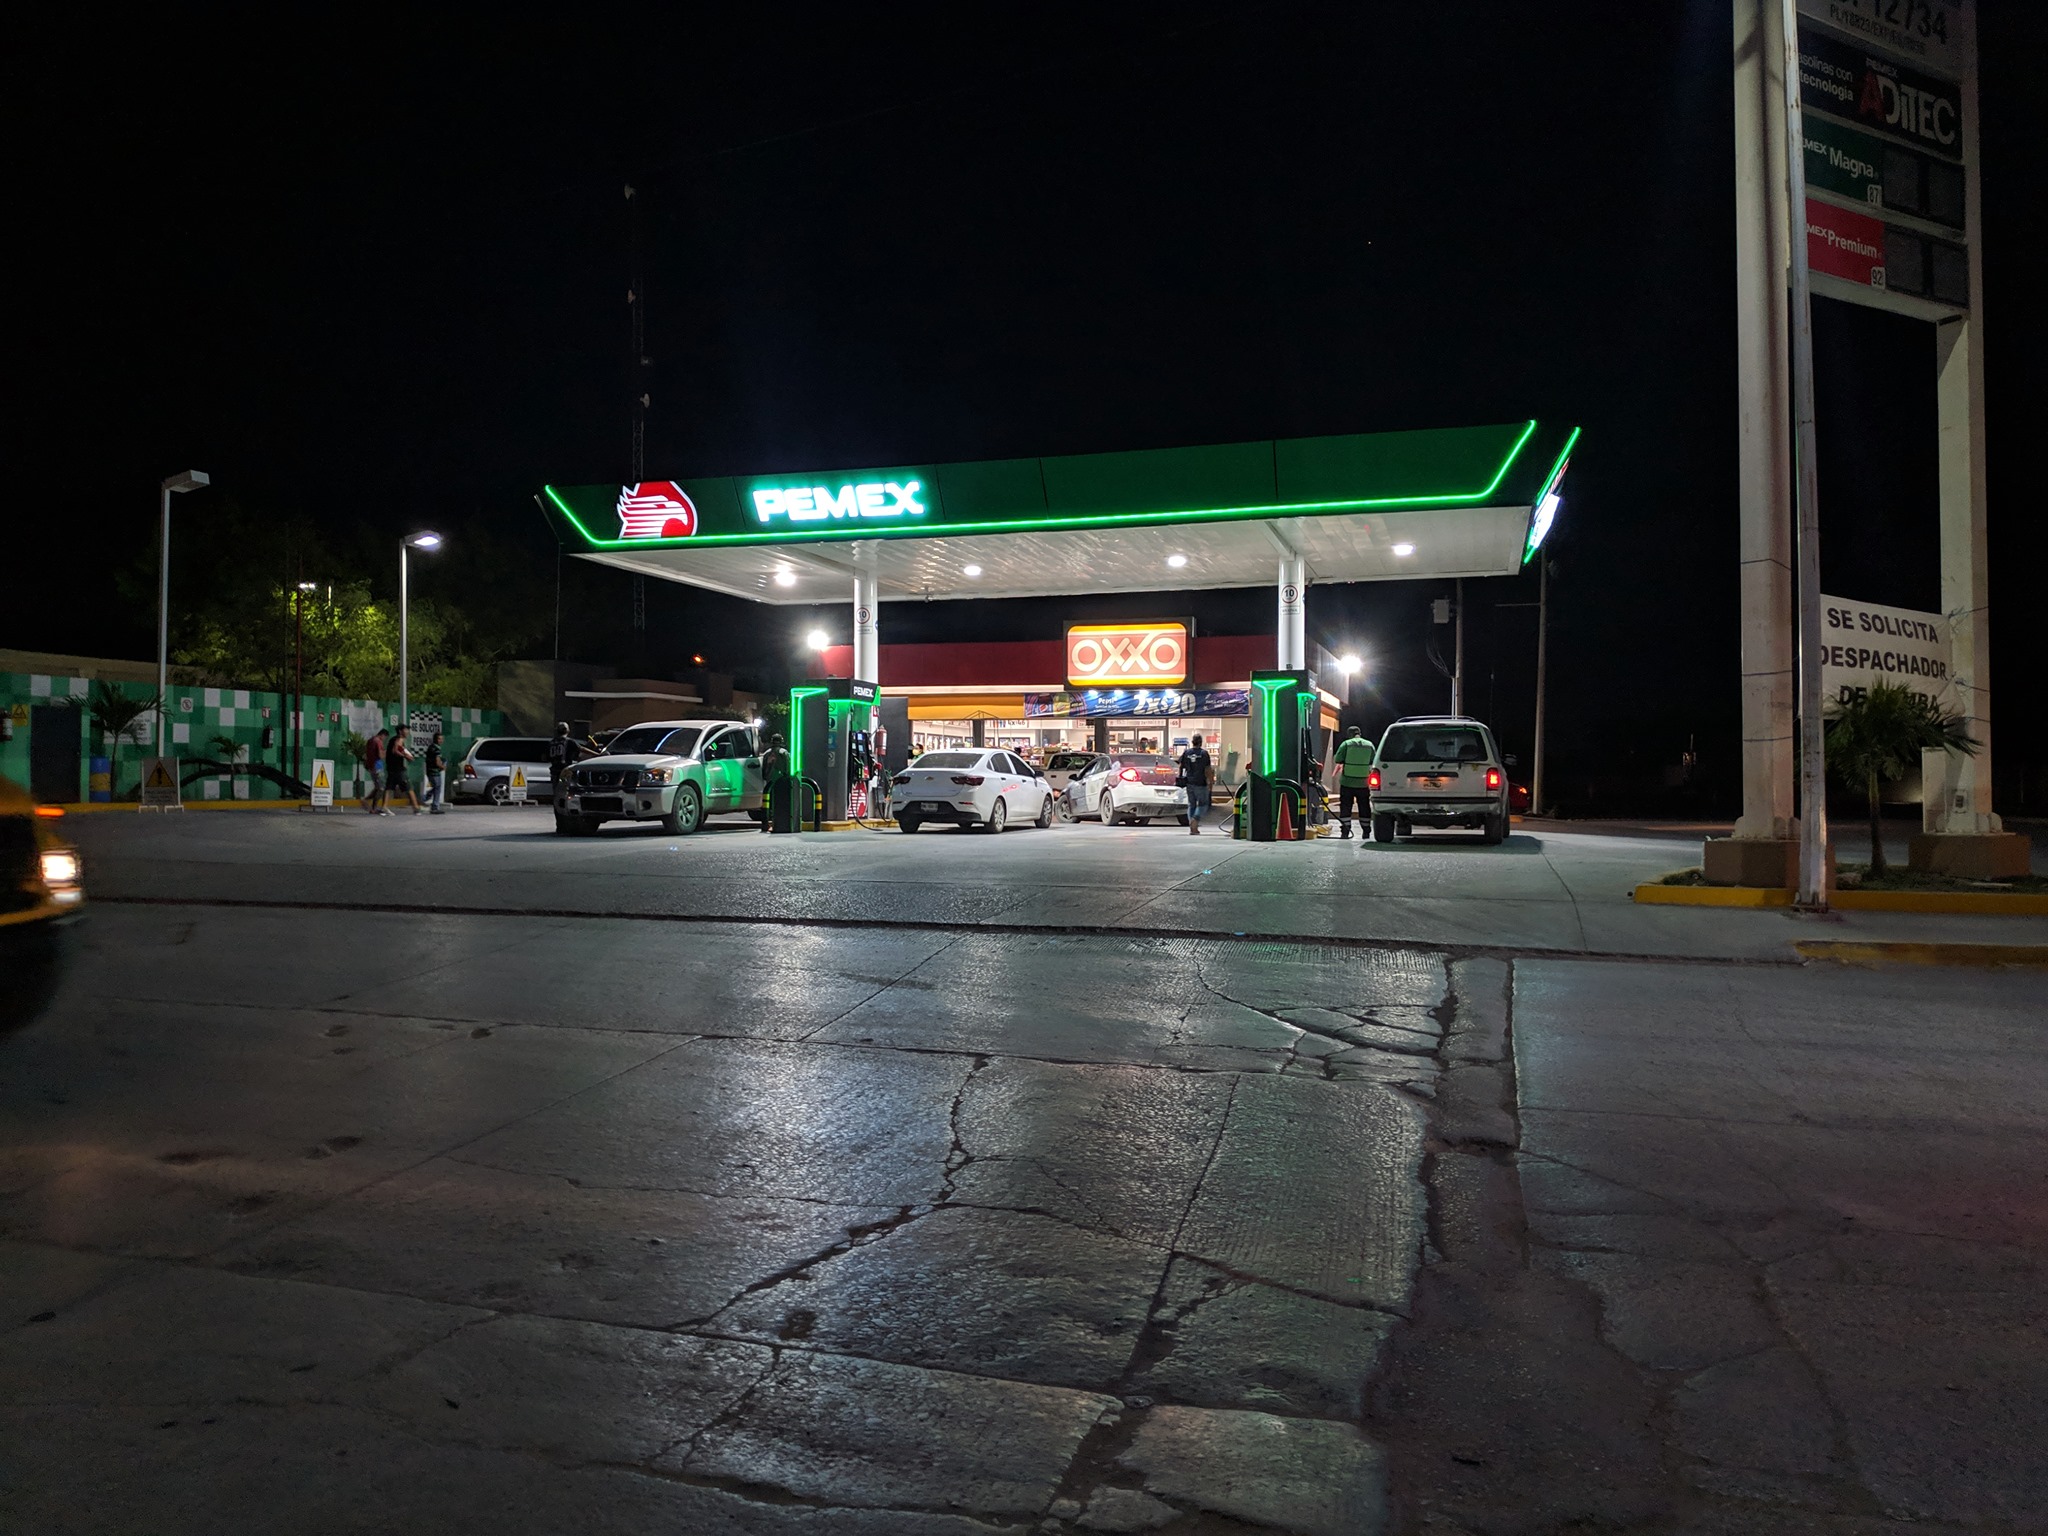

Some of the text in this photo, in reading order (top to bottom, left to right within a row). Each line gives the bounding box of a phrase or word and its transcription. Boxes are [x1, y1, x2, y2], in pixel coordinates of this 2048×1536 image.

[1835, 67, 1853, 82] con
[1865, 57, 1898, 79] PEMEX
[1803, 138, 1874, 178] MEX Magna
[1807, 223, 1878, 258] MEX Premium
[1872, 268, 1884, 286] 92
[752, 481, 925, 523] PEMEX
[1284, 589, 1294, 597] 10
[1827, 607, 1939, 644] SE SOLICITA
[1071, 634, 1182, 675] OXXO
[1821, 645, 1949, 681] DESPACHADOR
[853, 685, 874, 698] PEMEX
[1839, 685, 1868, 707] DE
[411, 722, 418, 732] SE
